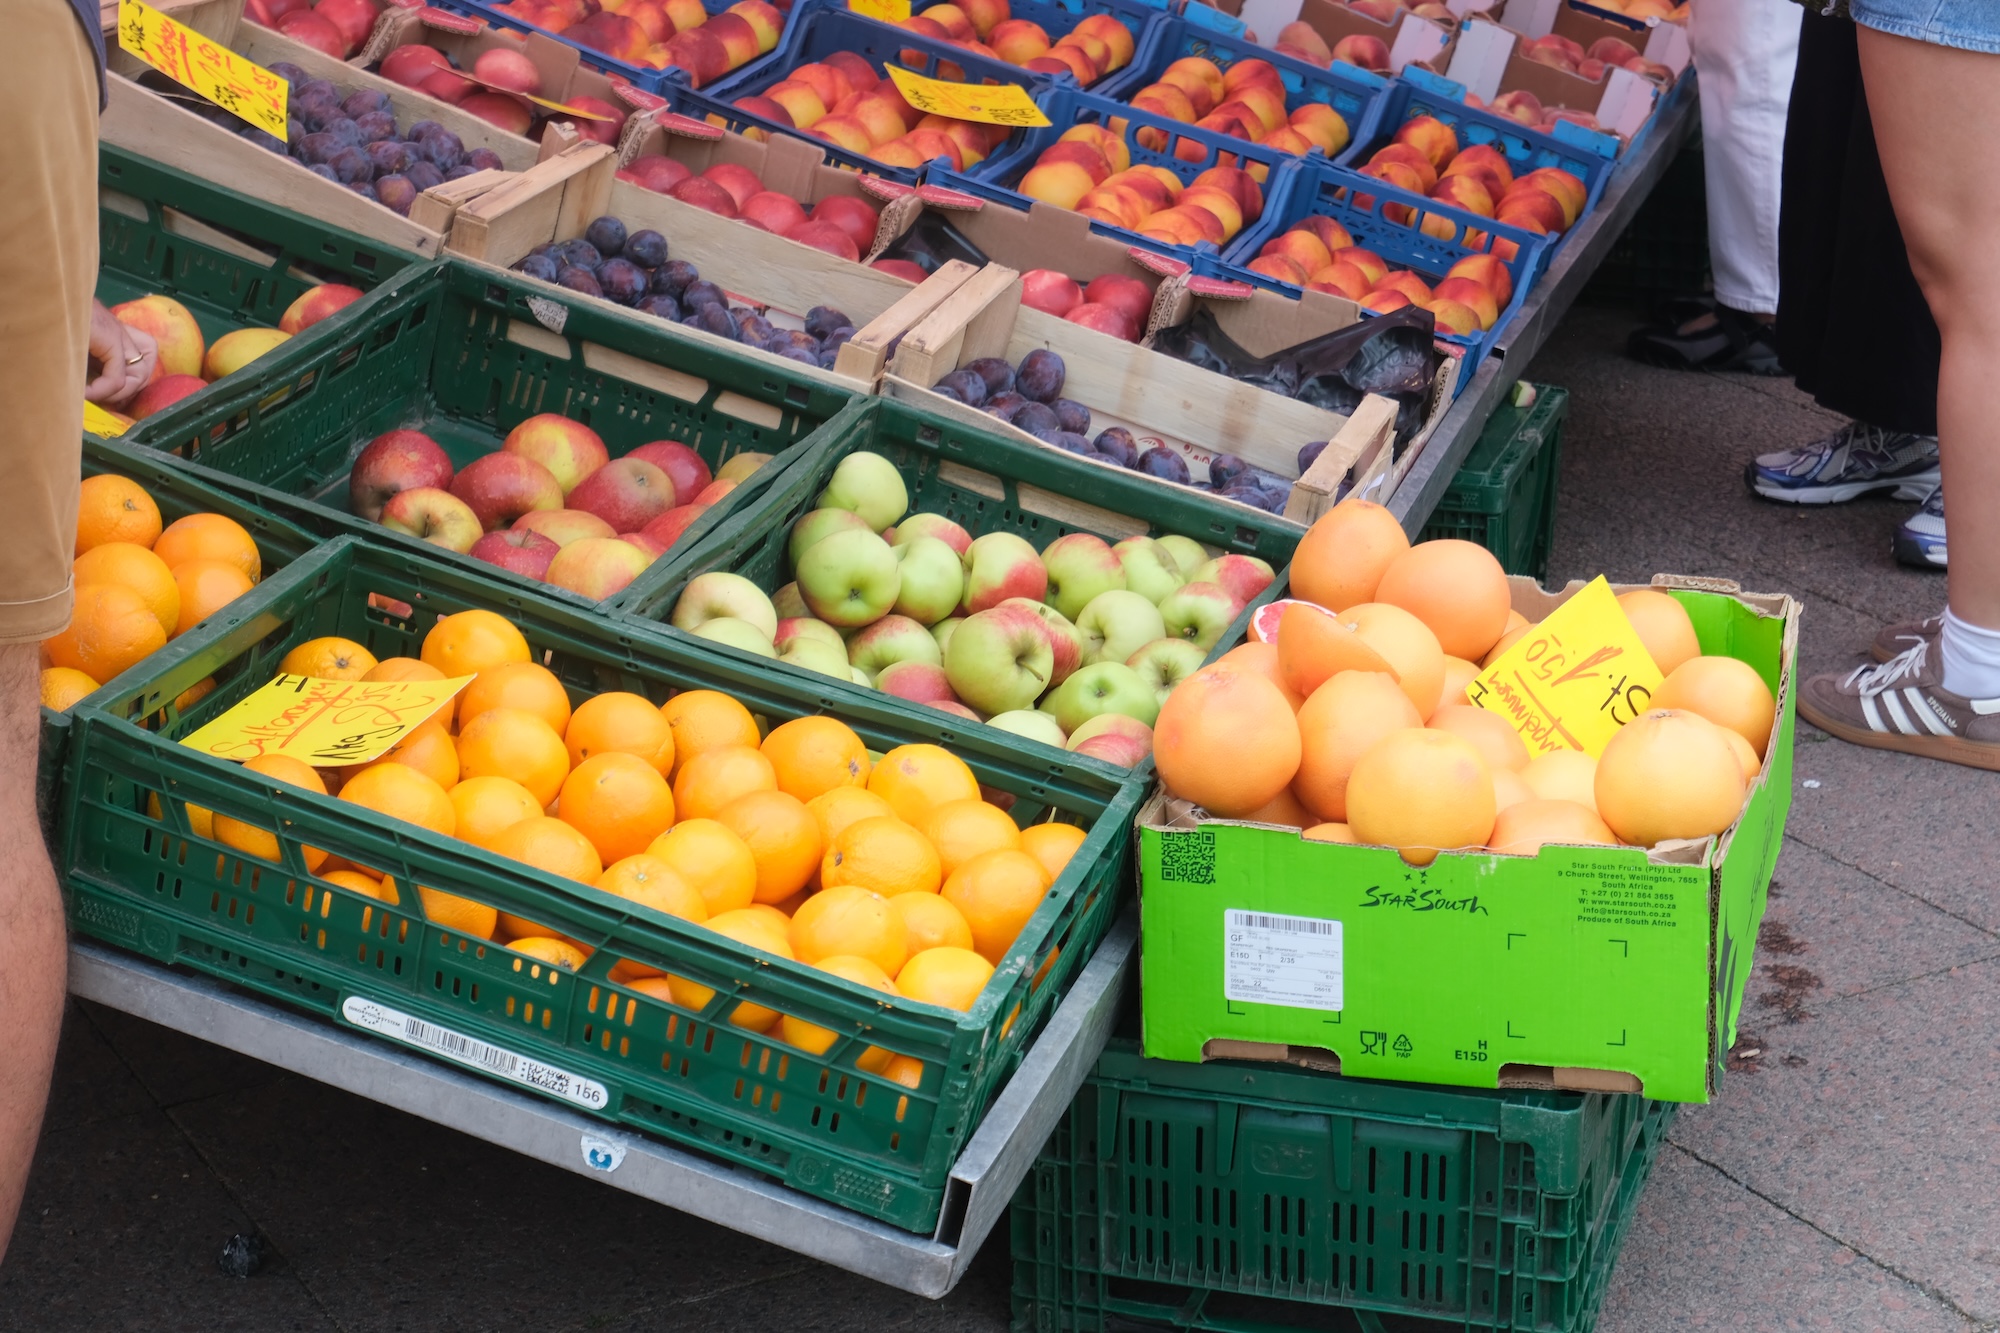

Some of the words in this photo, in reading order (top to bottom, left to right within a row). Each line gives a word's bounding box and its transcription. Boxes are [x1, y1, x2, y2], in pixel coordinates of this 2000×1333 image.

[1487, 670, 1564, 752] mpelmusen
[1926, 695, 1951, 724] SPEZIAL
[1591, 863, 1615, 871] South
[1618, 864, 1642, 872] Fruits
[1645, 865, 1665, 874] (Pty)
[1565, 871, 1595, 879] Church
[1597, 872, 1626, 881] Street,
[1628, 874, 1676, 884] Wellington,
[1601, 881, 1626, 889] South
[1610, 891, 1622, 899] (0)
[1654, 893, 1674, 901] 3655
[1591, 899, 1676, 910] www.starsouth.co.za
[1583, 907, 1671, 918] info@starsouth.co.za
[1577, 915, 1612, 924] Produce
[1625, 918, 1649, 926] South
[1652, 919, 1677, 927] Africa
[1230, 933, 1244, 942] GF
[1230, 951, 1250, 960] E15D
[1280, 956, 1296, 964] 2/35
[1478, 1040, 1487, 1050] H
[1455, 1050, 1488, 1062] E15D
[575, 1084, 601, 1103] 156
